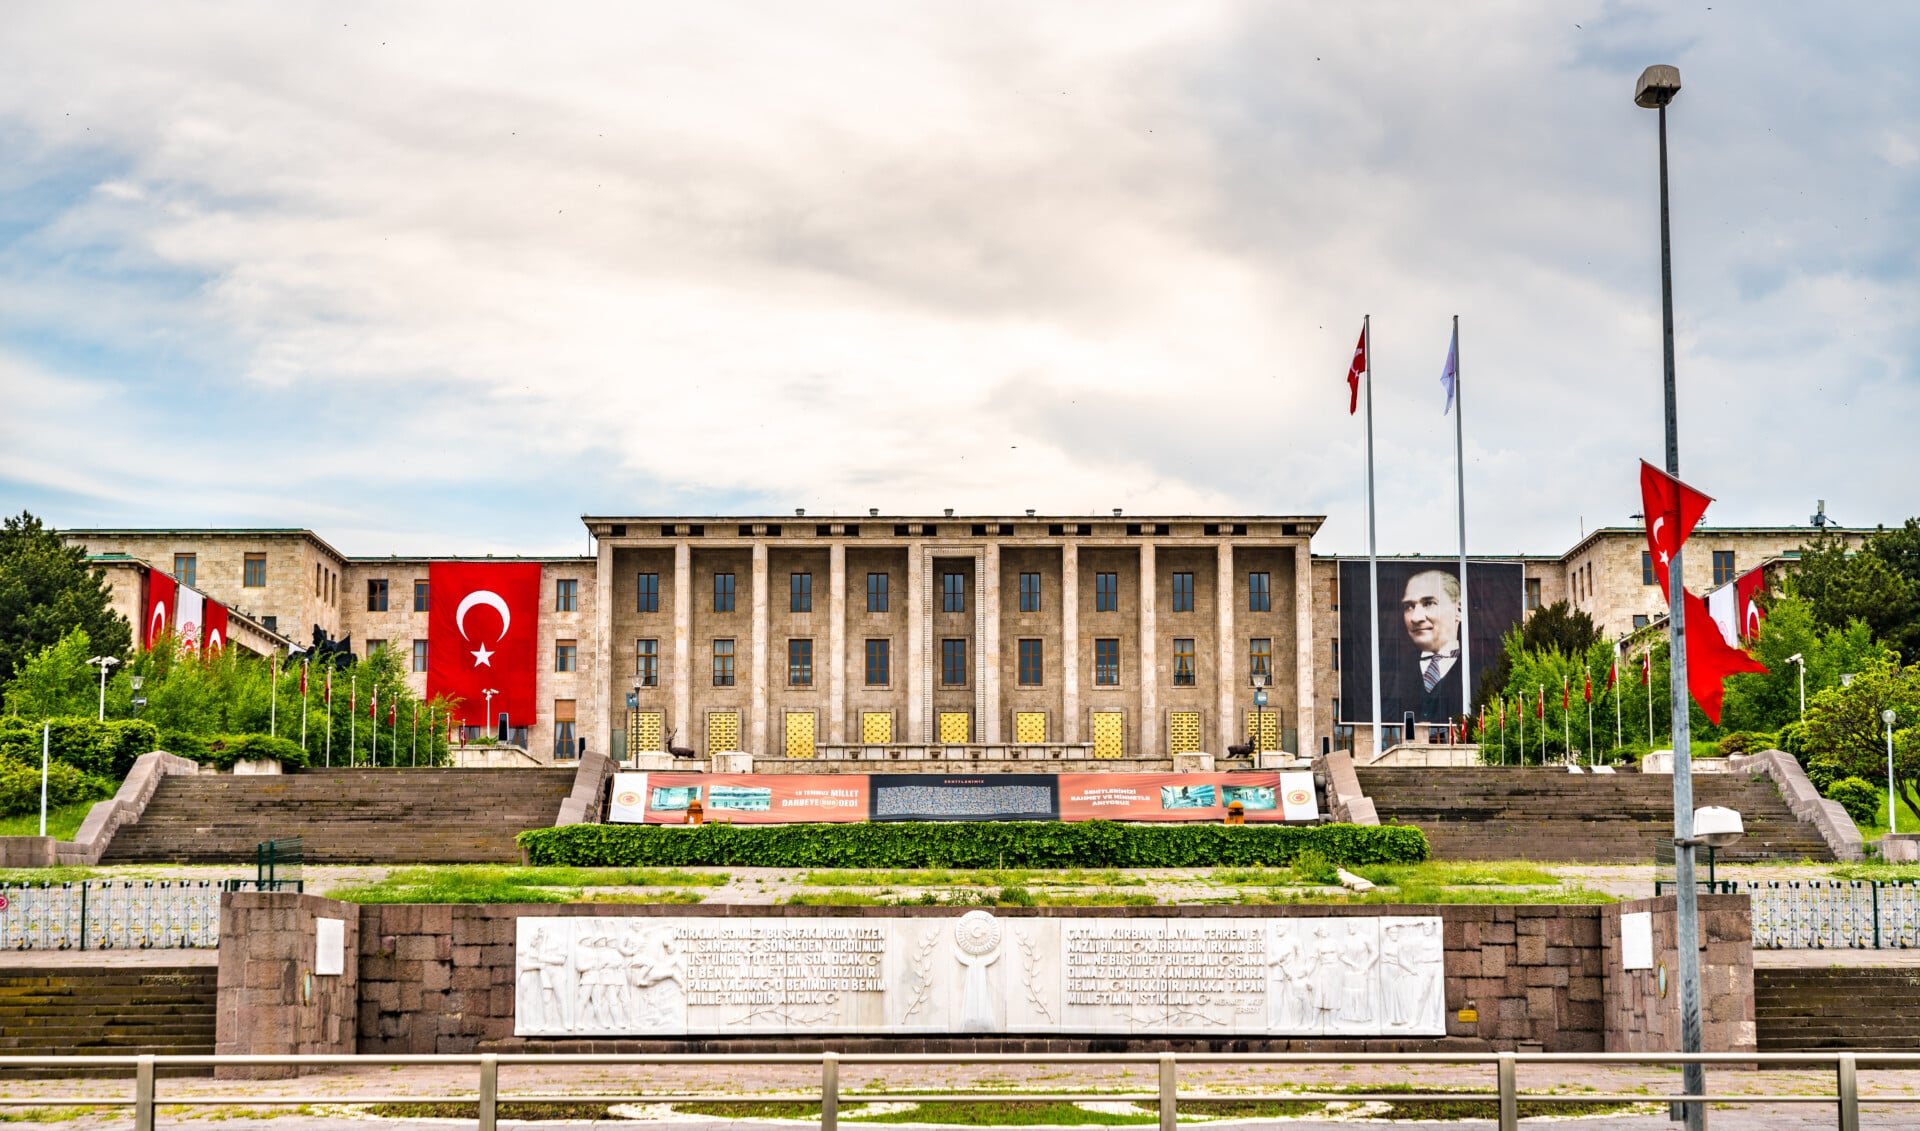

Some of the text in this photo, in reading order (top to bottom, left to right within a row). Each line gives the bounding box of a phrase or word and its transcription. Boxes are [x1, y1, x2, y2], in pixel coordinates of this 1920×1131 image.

[831, 788, 859, 797] MİLLET
[782, 798, 820, 807] DARBEYE
[767, 928, 780, 939] BU
[1112, 928, 1153, 939] KURBAN
[1250, 928, 1265, 939] EY
[699, 941, 743, 952] SANCAK
[826, 941, 886, 952] YURDUMUN
[1146, 941, 1205, 952] KAHRAMAN
[787, 954, 802, 965] EN
[805, 954, 828, 965] SON
[831, 954, 863, 965] OCAK
[1094, 954, 1108, 965] NE
[1110, 954, 1123, 965] BU
[1166, 954, 1180, 965] BU
[1236, 954, 1265, 965] SANA
[688, 967, 695, 978] O
[1067, 967, 1105, 978] OLMAZ
[1227, 967, 1265, 978] SONRA
[1185, 980, 1224, 991] HAKKA
[1228, 980, 1265, 991] TAPAN
[780, 993, 820, 1004] ANCAK
